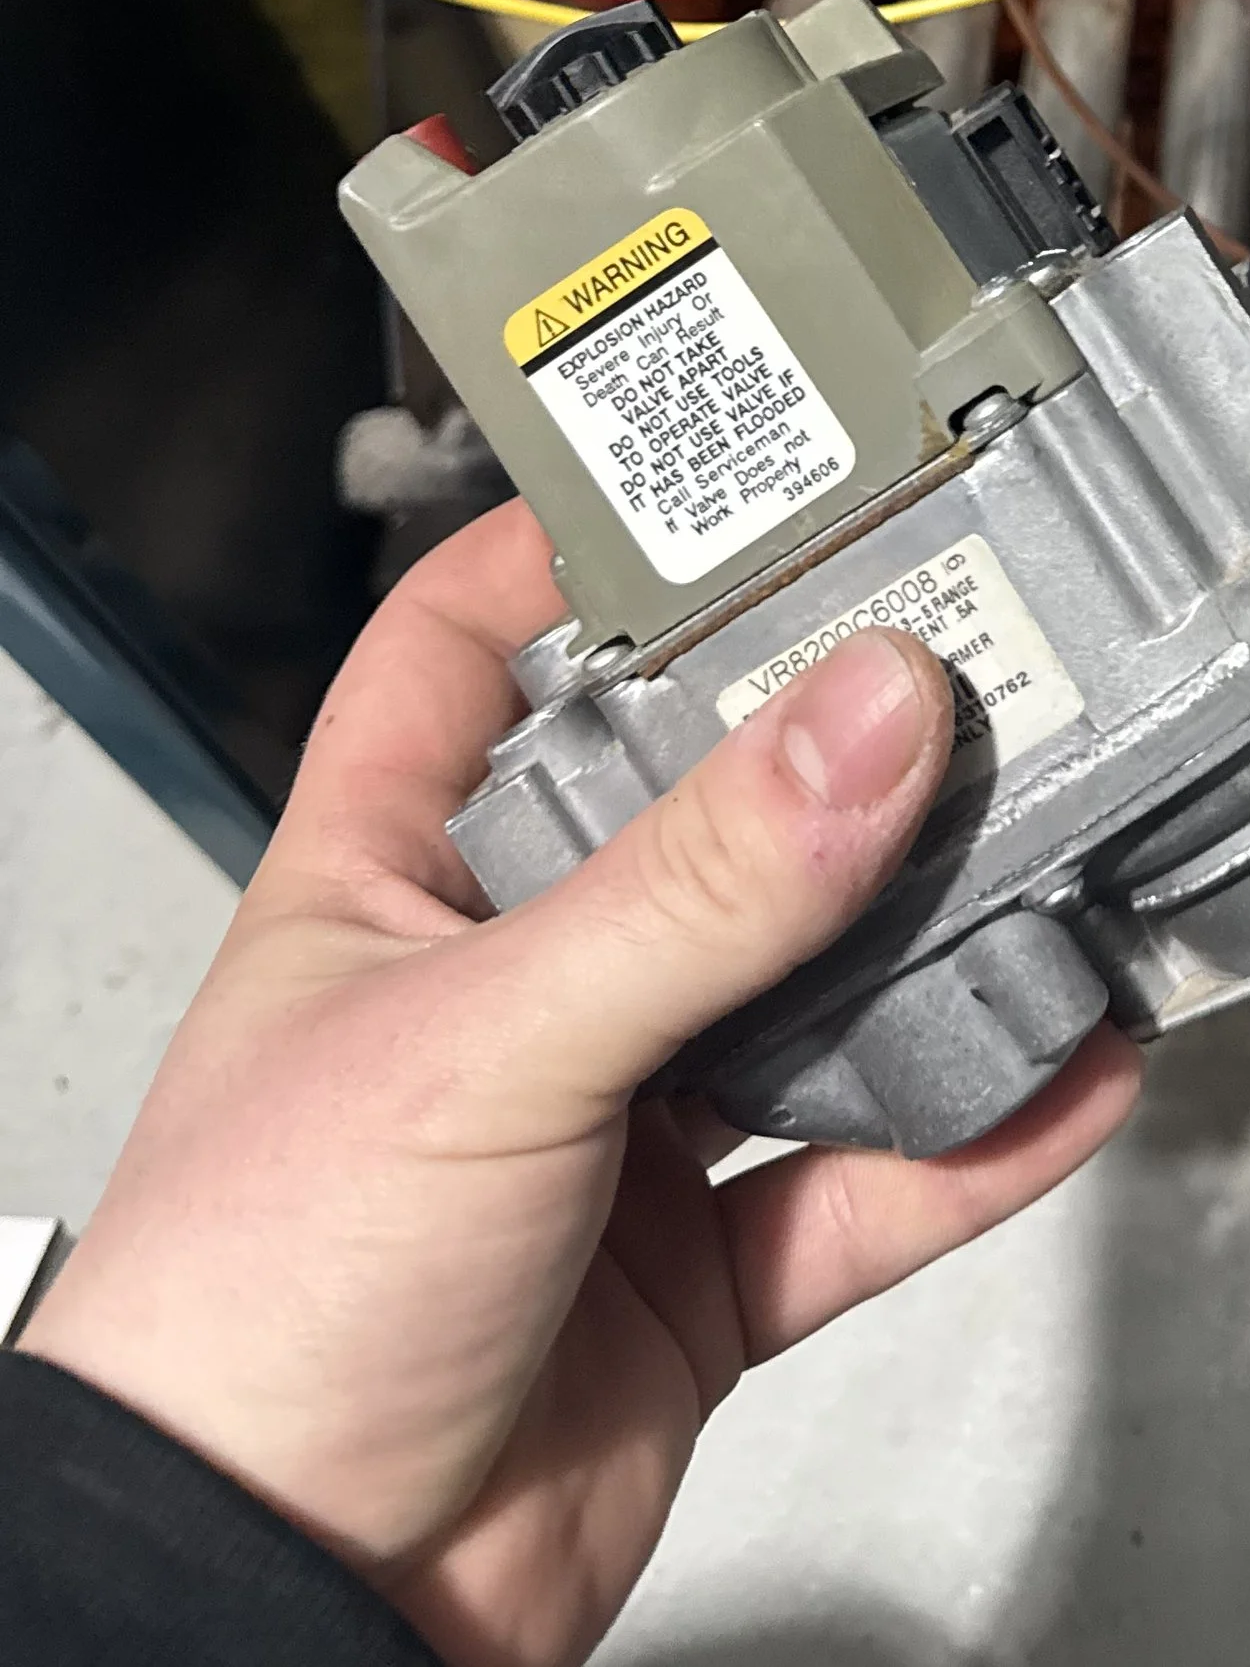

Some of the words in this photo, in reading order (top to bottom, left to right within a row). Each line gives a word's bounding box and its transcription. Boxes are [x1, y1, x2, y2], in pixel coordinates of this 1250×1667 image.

[563, 222, 691, 314] WARNING
[557, 314, 645, 380] EXPLOSION
[643, 272, 707, 321] HAZARD
[575, 350, 630, 390] Severe
[637, 312, 682, 349] Injury
[691, 291, 713, 312] Or
[583, 372, 629, 408] Death
[636, 346, 670, 371] Can
[677, 307, 725, 345] Result
[611, 387, 638, 411] DO
[638, 361, 676, 393] NOT
[674, 330, 722, 367] TAKE
[608, 434, 634, 458] DO
[638, 408, 672, 439] NOT
[675, 382, 710, 412] USE
[711, 345, 764, 387] TOOLS
[619, 450, 644, 472] TO
[648, 398, 721, 453] OPERATE
[721, 363, 773, 402] VALVE
[620, 472, 646, 496] DO
[650, 445, 685, 475] NOT
[688, 419, 724, 449] USE
[725, 383, 776, 423] VALVE
[778, 368, 795, 388] IF
[621, 385, 673, 425] VALVE
[677, 346, 729, 390] APART
[629, 493, 646, 513] IT
[650, 469, 684, 499] HAS
[687, 436, 731, 473] BEEN
[733, 385, 806, 441] FLOODED
[657, 486, 692, 515] Call
[695, 421, 791, 490] Serviceman
[664, 517, 680, 534] If
[685, 487, 728, 519] Valve
[733, 455, 775, 487] Does
[783, 428, 812, 454] not
[783, 456, 840, 501] 394606
[690, 504, 734, 536] Work
[748, 570, 938, 696] VR8200C6008
[931, 575, 978, 613] RANGE
